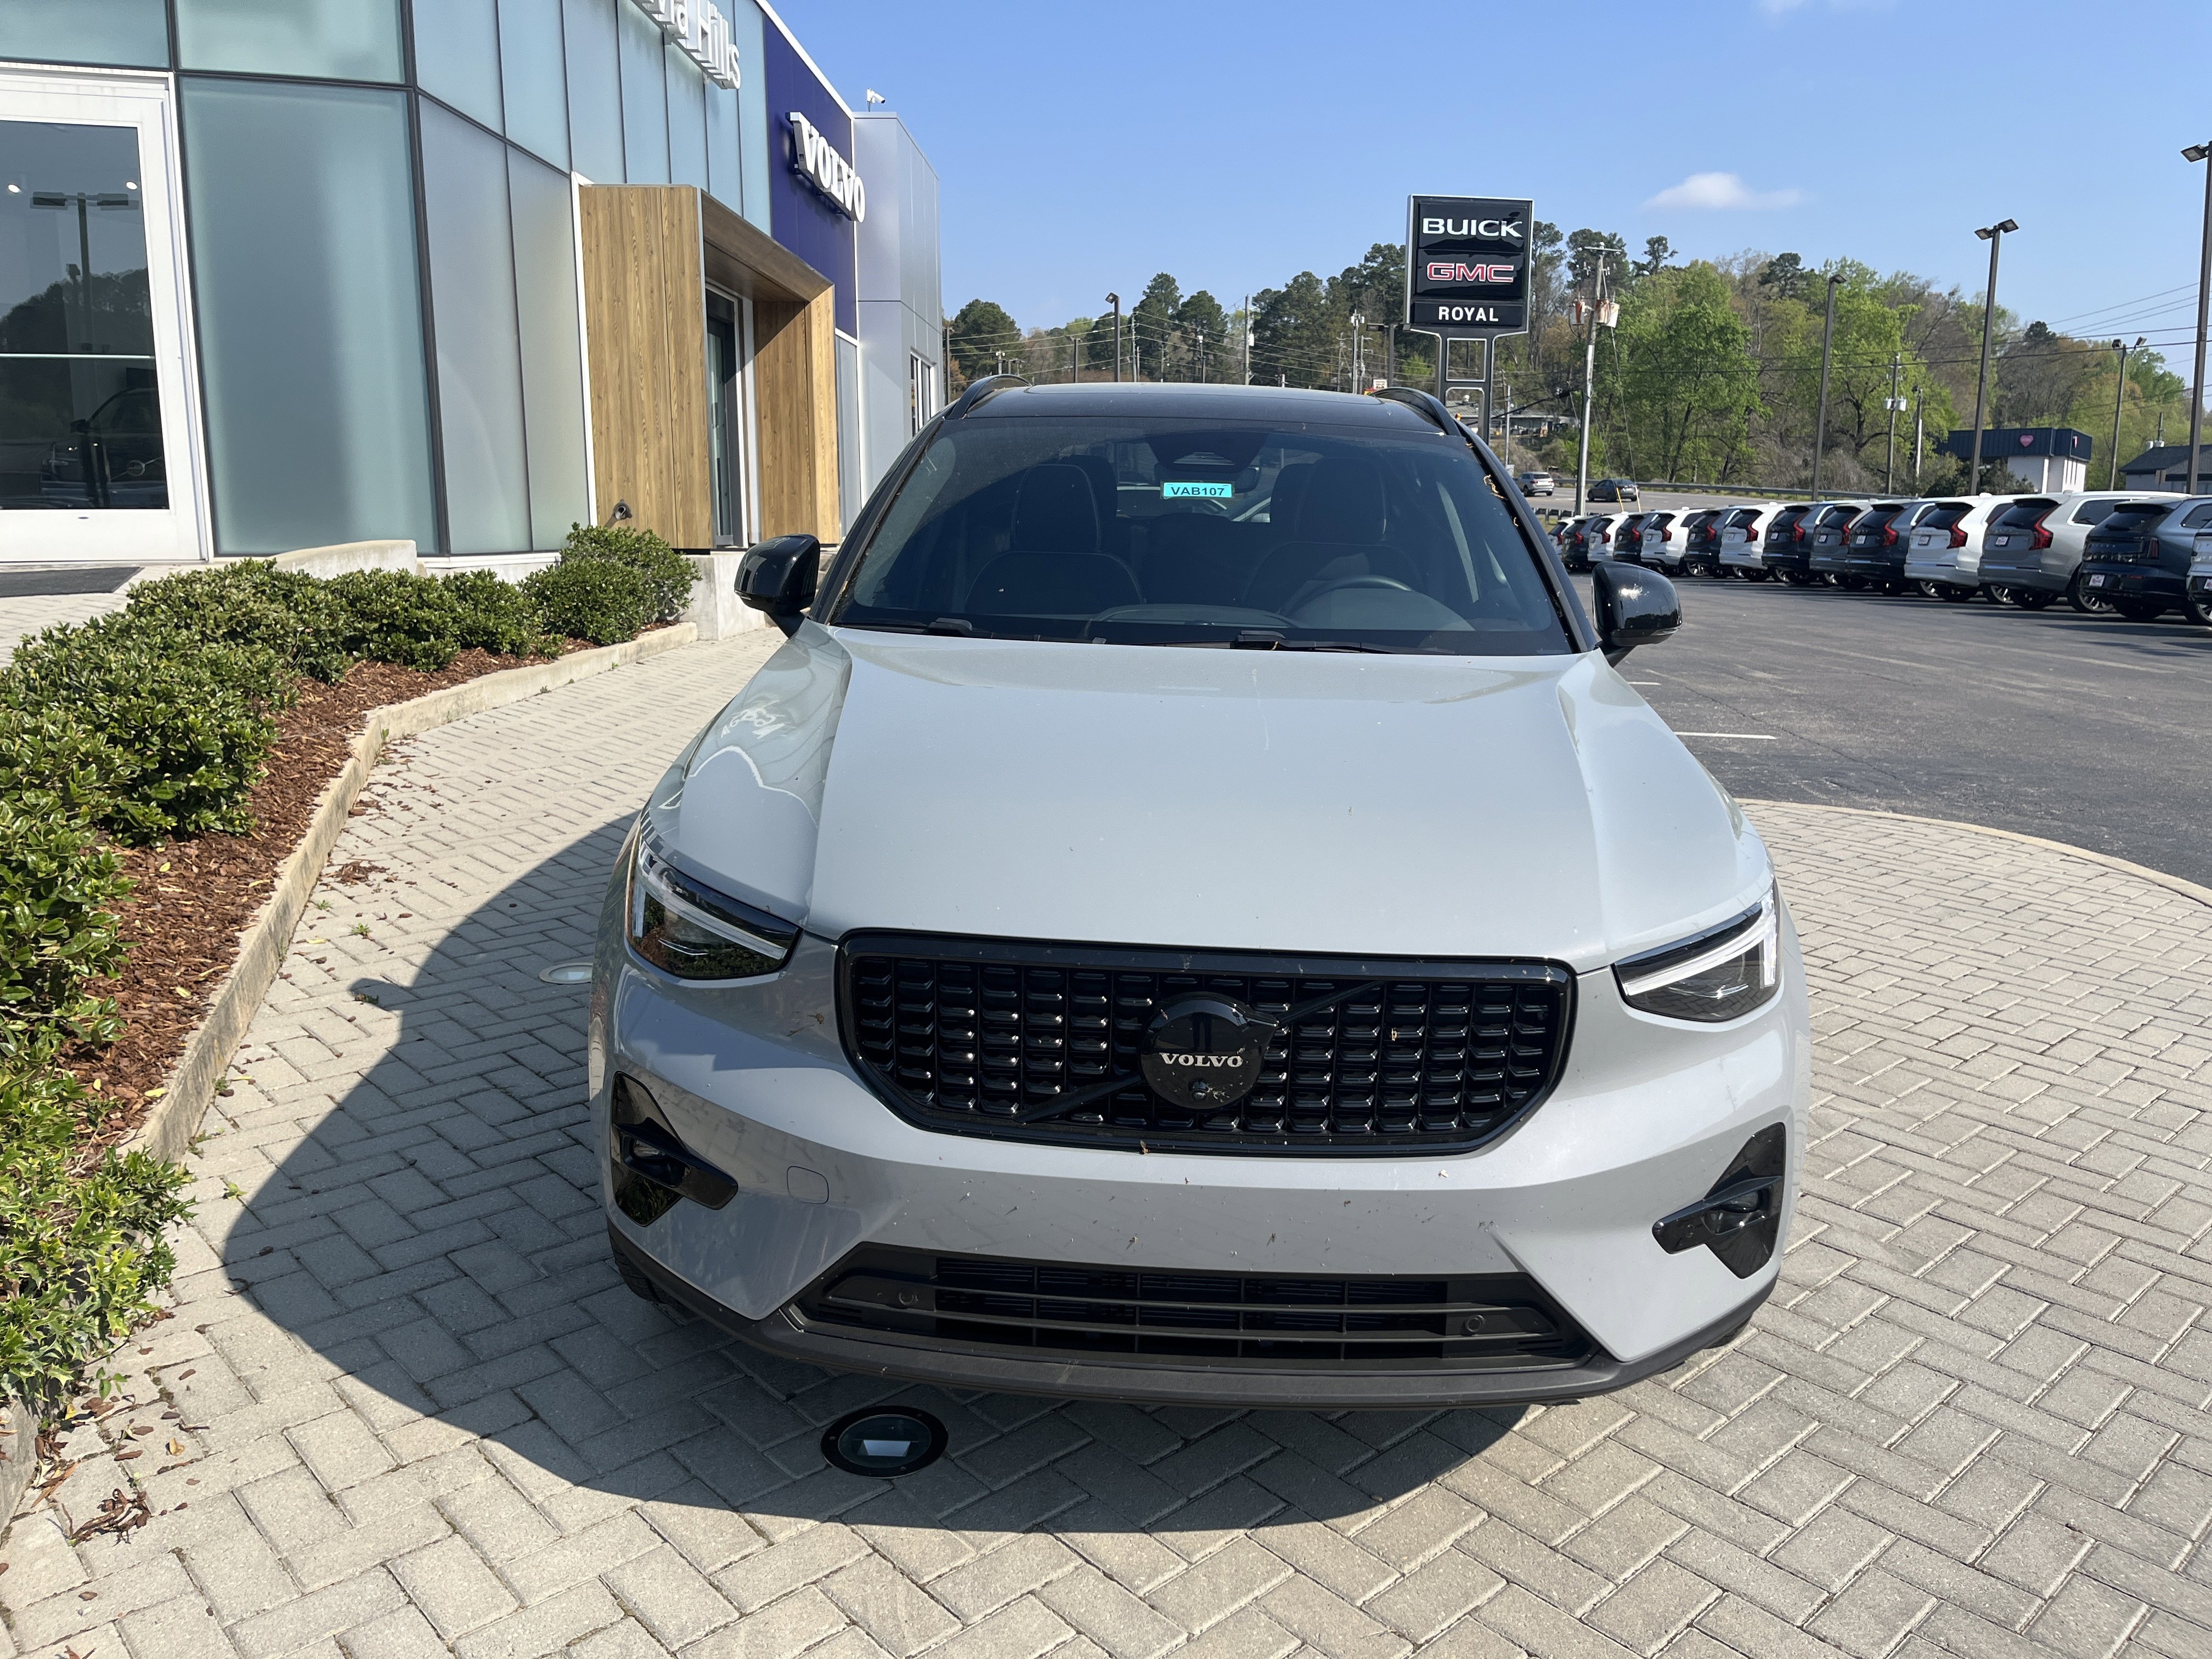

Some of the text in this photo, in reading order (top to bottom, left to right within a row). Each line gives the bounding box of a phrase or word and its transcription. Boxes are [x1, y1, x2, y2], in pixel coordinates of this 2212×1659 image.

[686, 0, 741, 89] Hills
[790, 112, 866, 223] VOLVO
[1423, 218, 1523, 238] BUICK
[1427, 262, 1514, 283] GMC
[1438, 306, 1499, 321] ROYAL
[1170, 486, 1225, 496] VAB107
[1159, 1052, 1243, 1068] VOLVO
